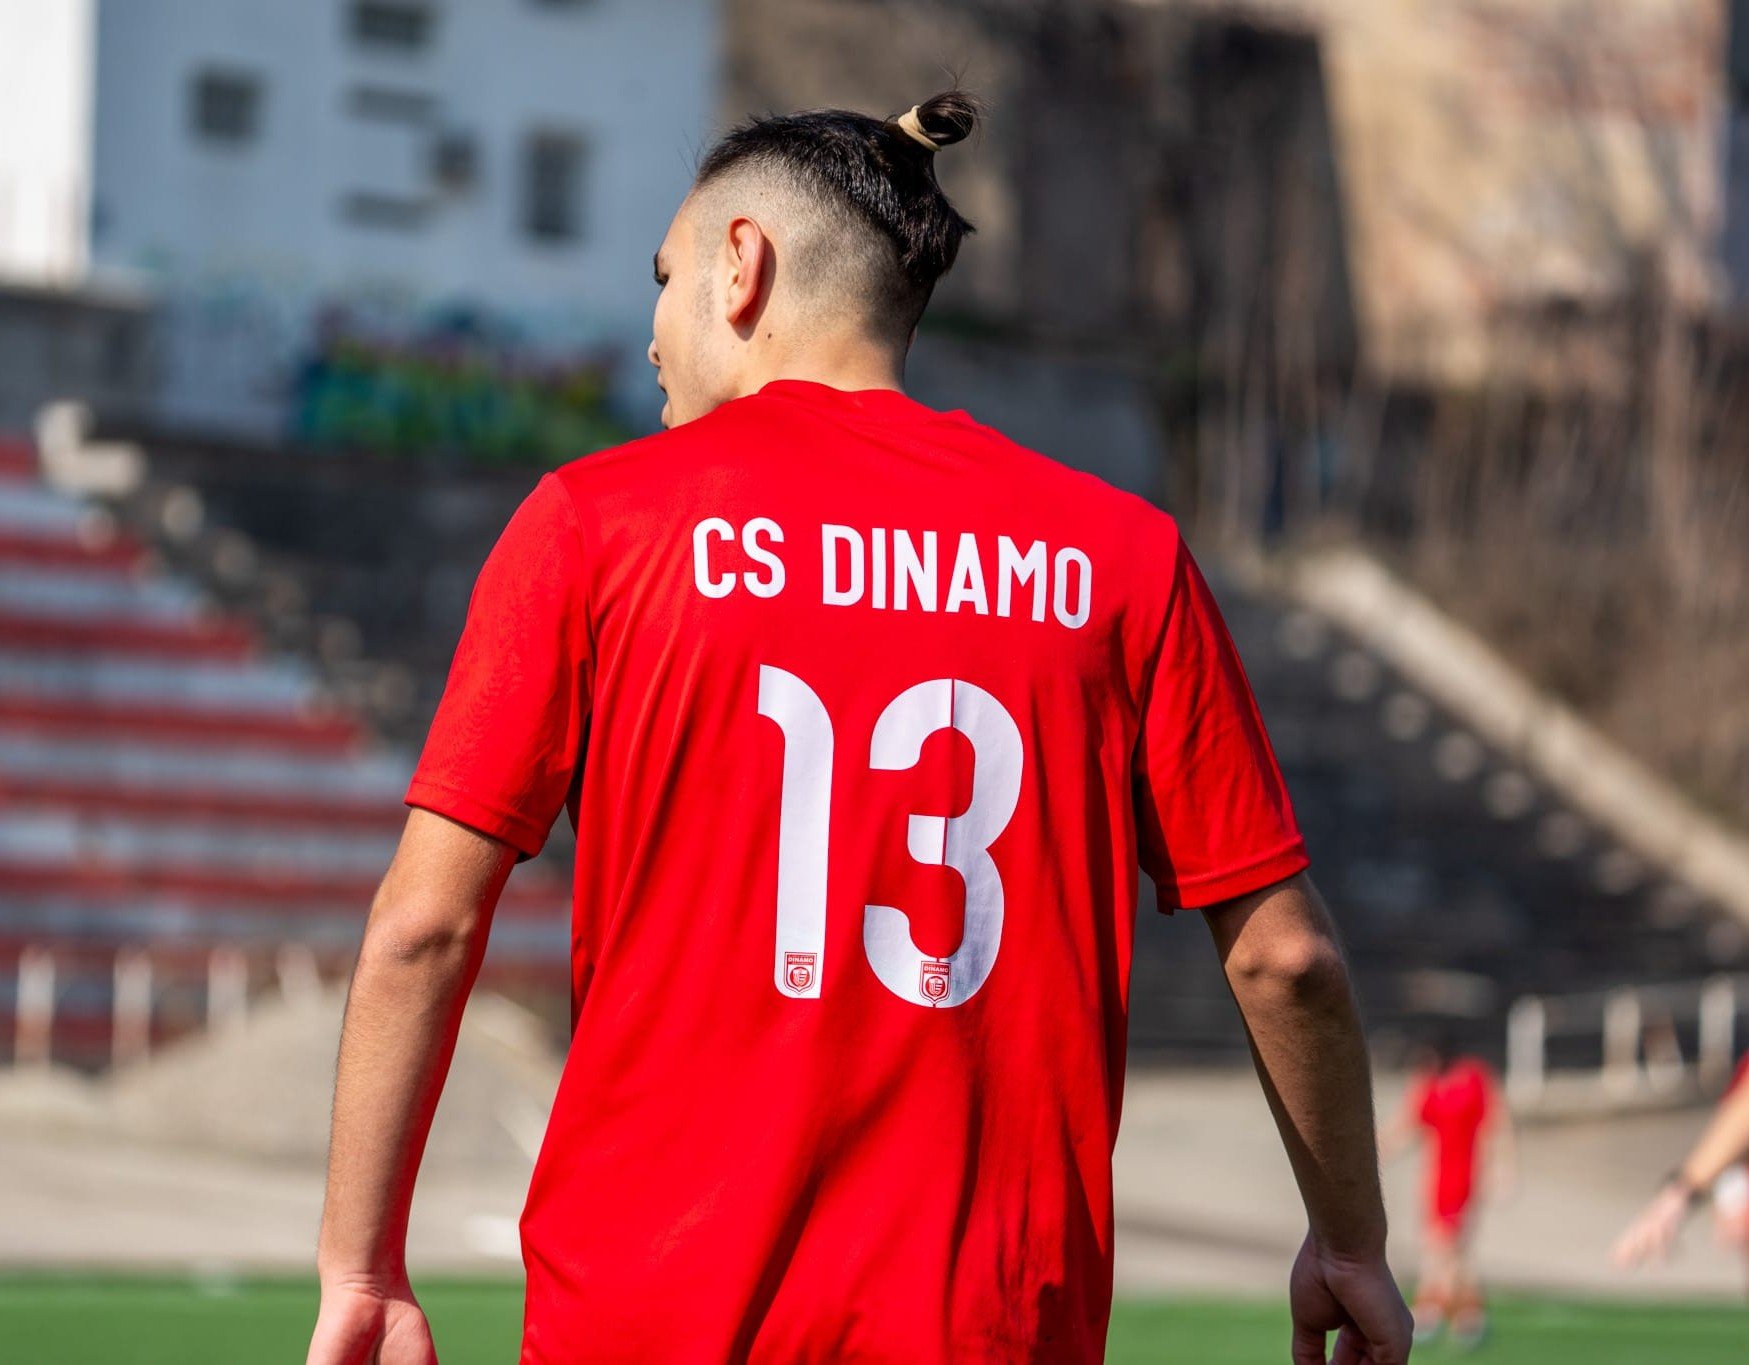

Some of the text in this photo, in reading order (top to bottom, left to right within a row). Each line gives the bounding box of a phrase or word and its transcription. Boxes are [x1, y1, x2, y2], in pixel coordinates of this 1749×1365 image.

[692, 517, 1093, 630] CS DINAMO
[757, 664, 1024, 1009] 13
